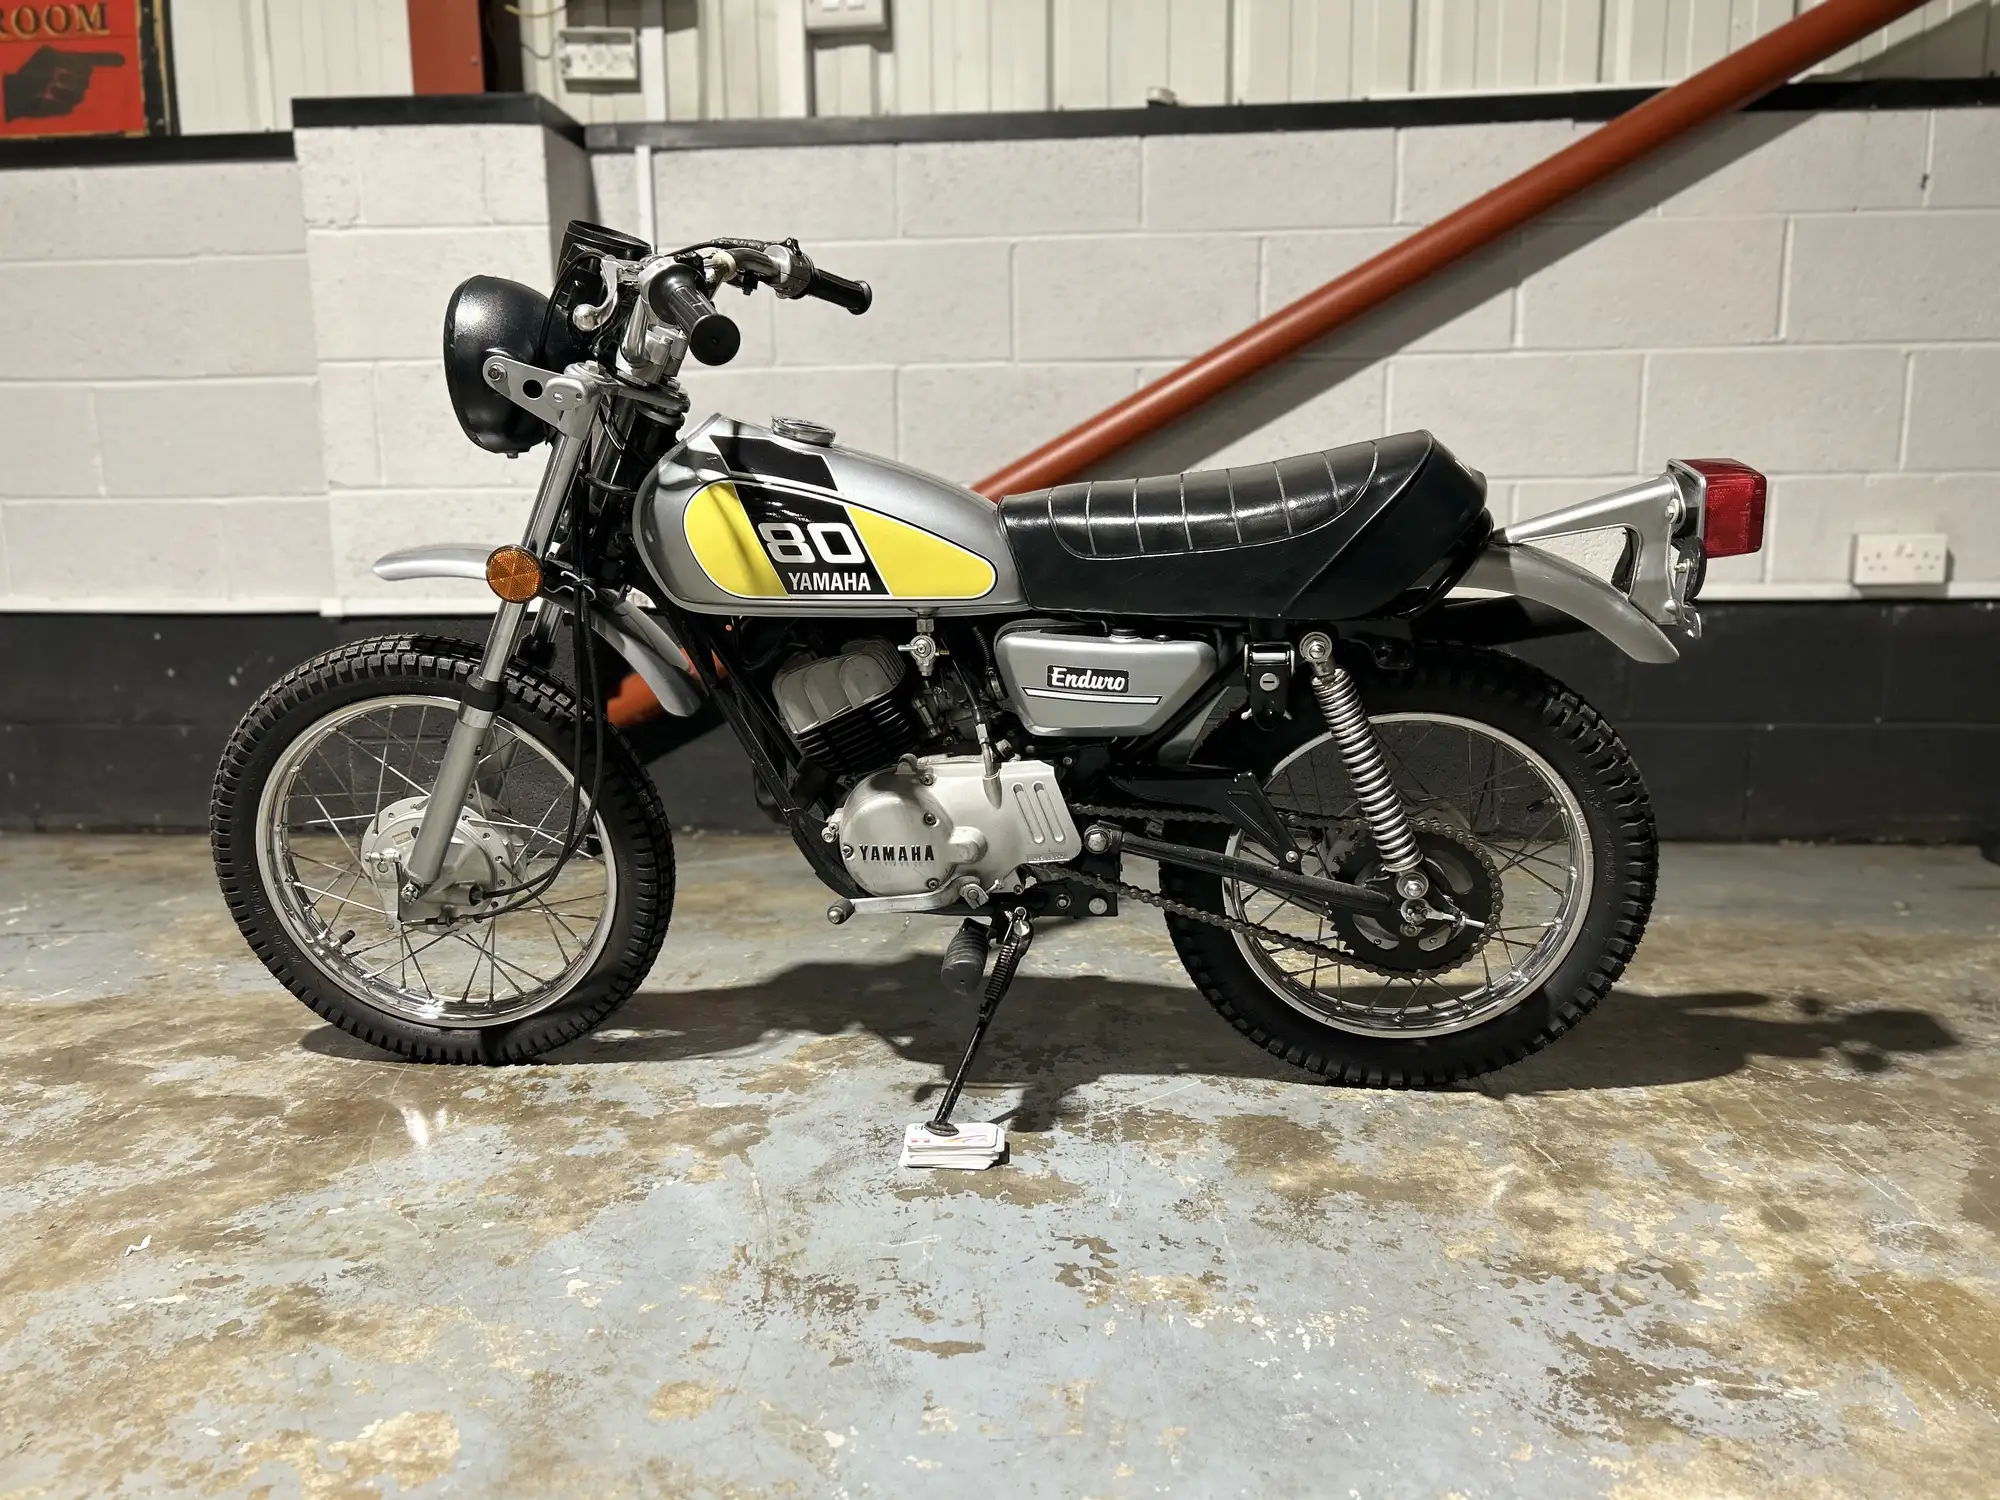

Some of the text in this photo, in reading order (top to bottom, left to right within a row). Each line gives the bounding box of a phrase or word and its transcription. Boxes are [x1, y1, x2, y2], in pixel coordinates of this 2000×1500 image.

[758, 522, 866, 563] 80
[788, 572, 871, 591] YAMAHA
[1051, 666, 1125, 691] Enduro
[859, 844, 935, 861] YAMAHA
